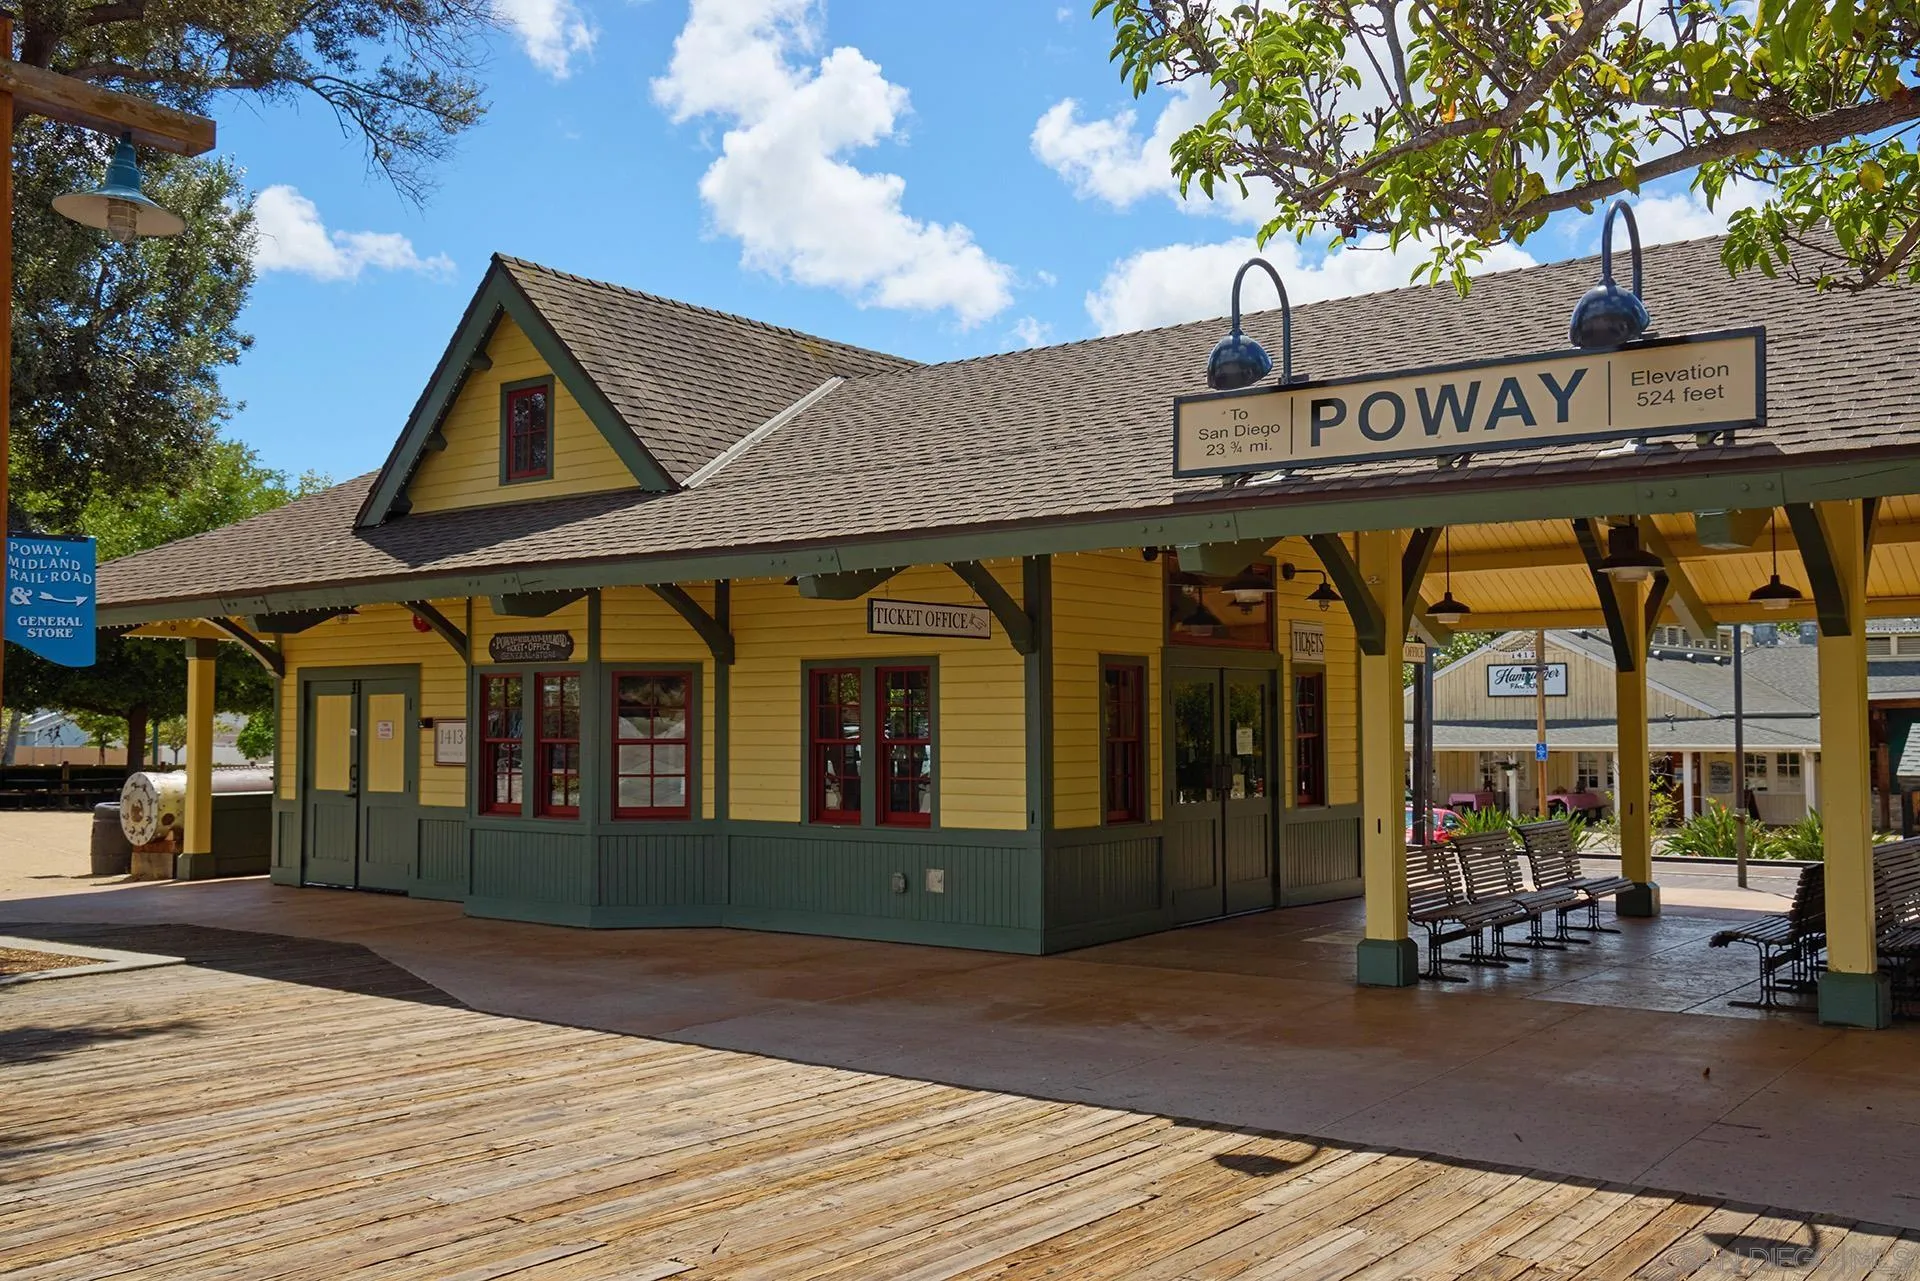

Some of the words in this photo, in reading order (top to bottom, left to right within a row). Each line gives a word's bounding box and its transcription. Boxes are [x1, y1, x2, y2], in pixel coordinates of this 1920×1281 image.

[1631, 363, 1730, 387] Elevation
[1636, 391, 1676, 407] 524
[1683, 384, 1725, 402] feet
[1230, 408, 1249, 421] To
[1310, 368, 1589, 448] POWAY
[1198, 428, 1229, 441] San
[1234, 423, 1281, 438] Diego
[1205, 444, 1226, 456] 23
[1249, 439, 1272, 453] mi.
[10, 541, 63, 556] POWAY
[8, 554, 81, 571] MIDLAND
[10, 586, 33, 606] &
[17, 615, 83, 627] GENERAL
[874, 606, 923, 626] TICKET
[925, 610, 968, 629] OFFICE
[27, 627, 74, 638] STORE
[1294, 631, 1324, 656] TICKETS
